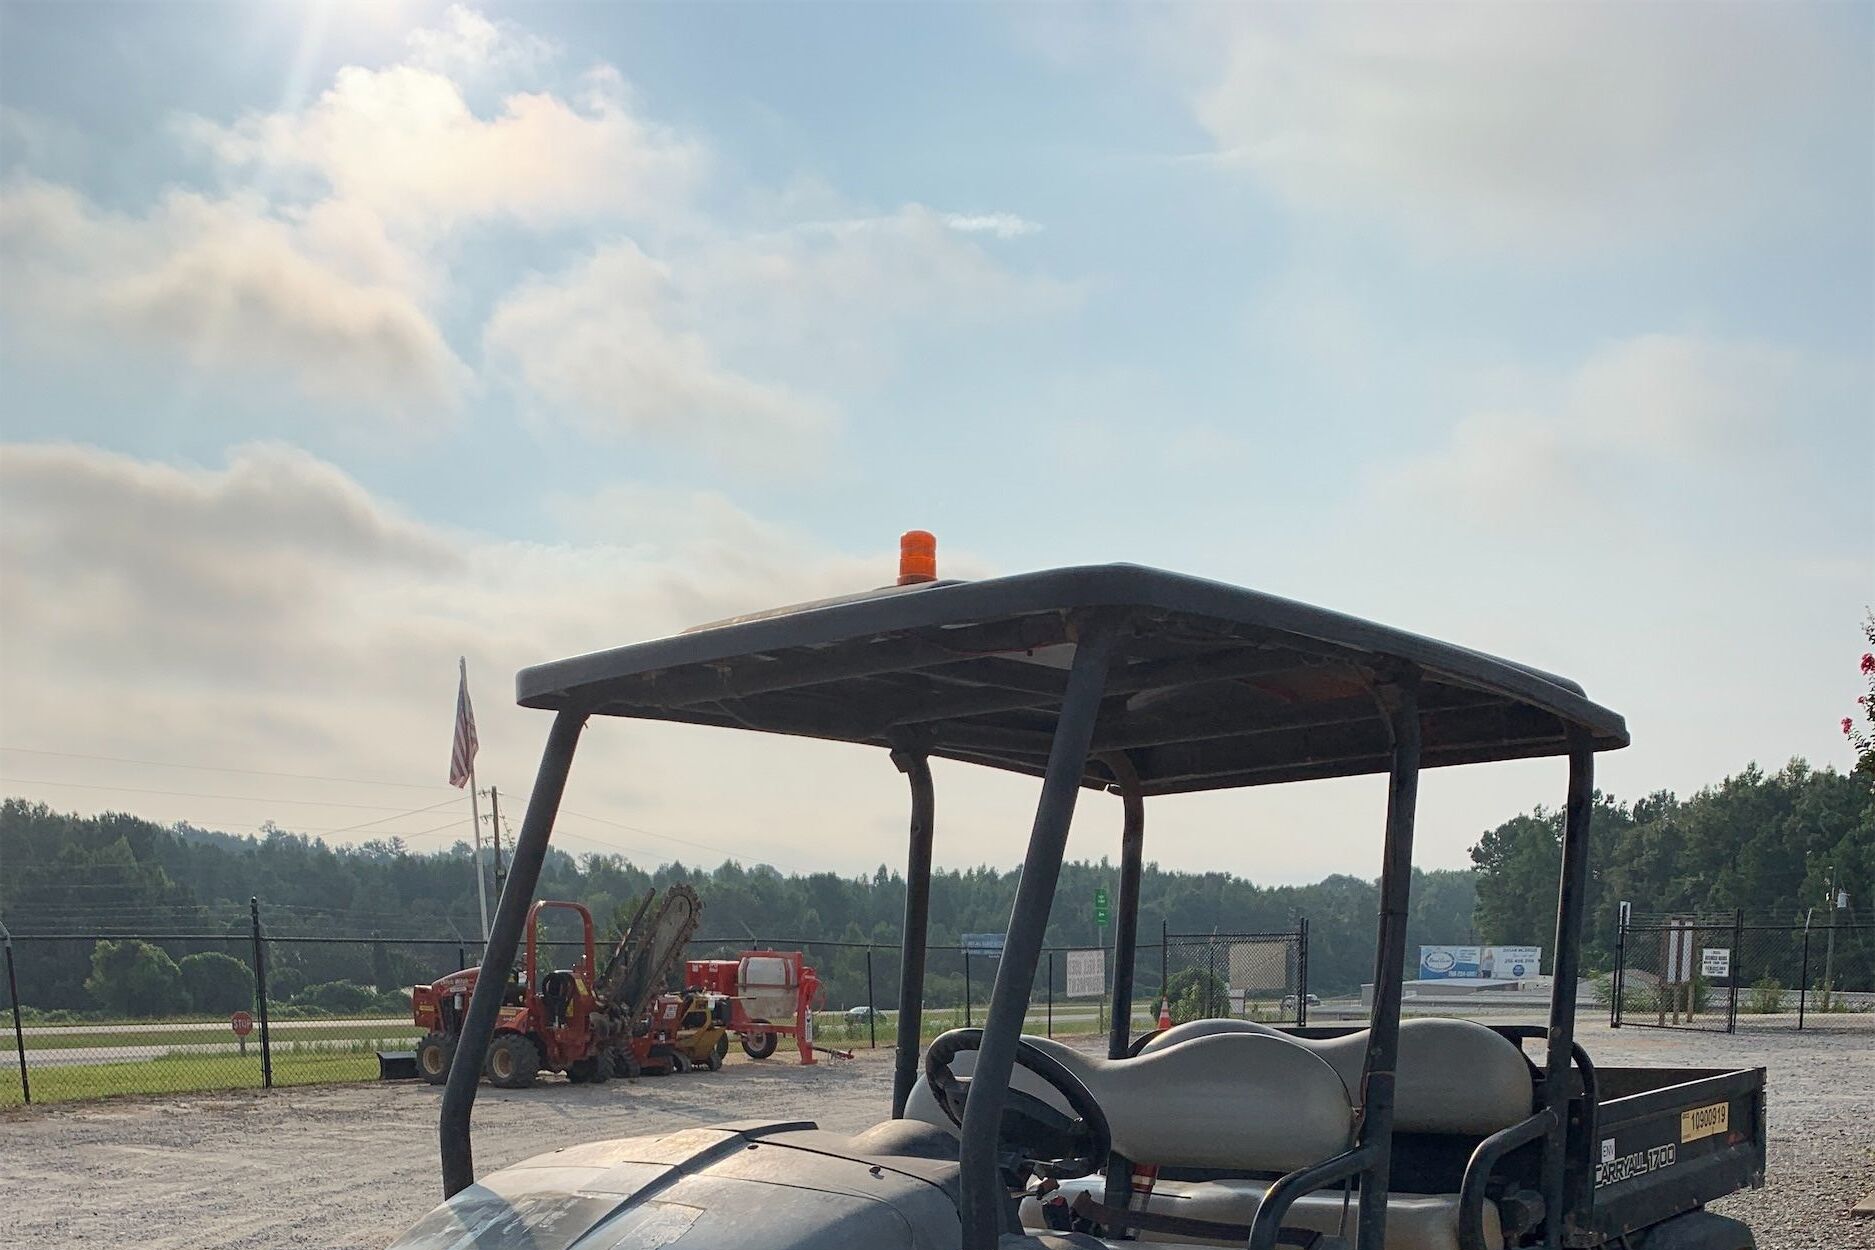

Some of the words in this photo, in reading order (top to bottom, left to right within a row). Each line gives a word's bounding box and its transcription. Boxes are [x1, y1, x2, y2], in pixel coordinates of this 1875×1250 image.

[233, 1018, 251, 1029] STOP
[1692, 1105, 1726, 1131] 10900919
[1648, 1142, 1675, 1171] 1700
